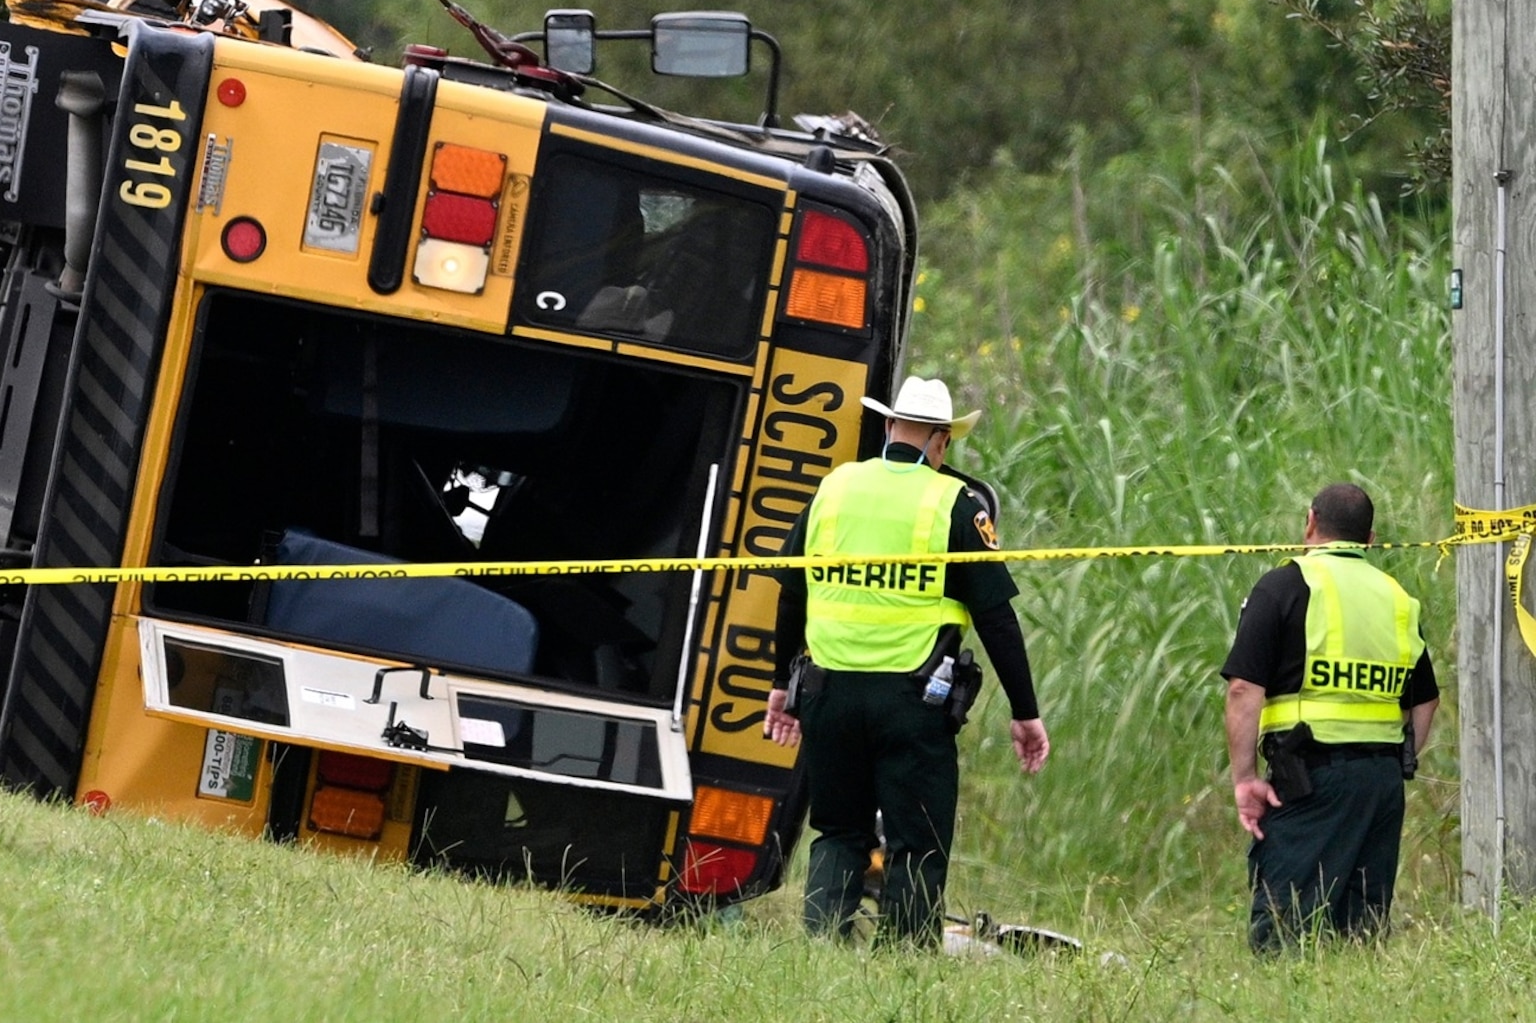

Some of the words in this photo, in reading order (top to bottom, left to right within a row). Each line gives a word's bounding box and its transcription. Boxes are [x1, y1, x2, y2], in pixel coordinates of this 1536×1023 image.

[119, 100, 186, 209] 1819
[536, 290, 566, 311] C
[735, 373, 844, 591] SCHOOL
[811, 556, 937, 591] SHERIFF
[710, 623, 776, 740] BUS
[1311, 660, 1415, 694] SHERIFF
